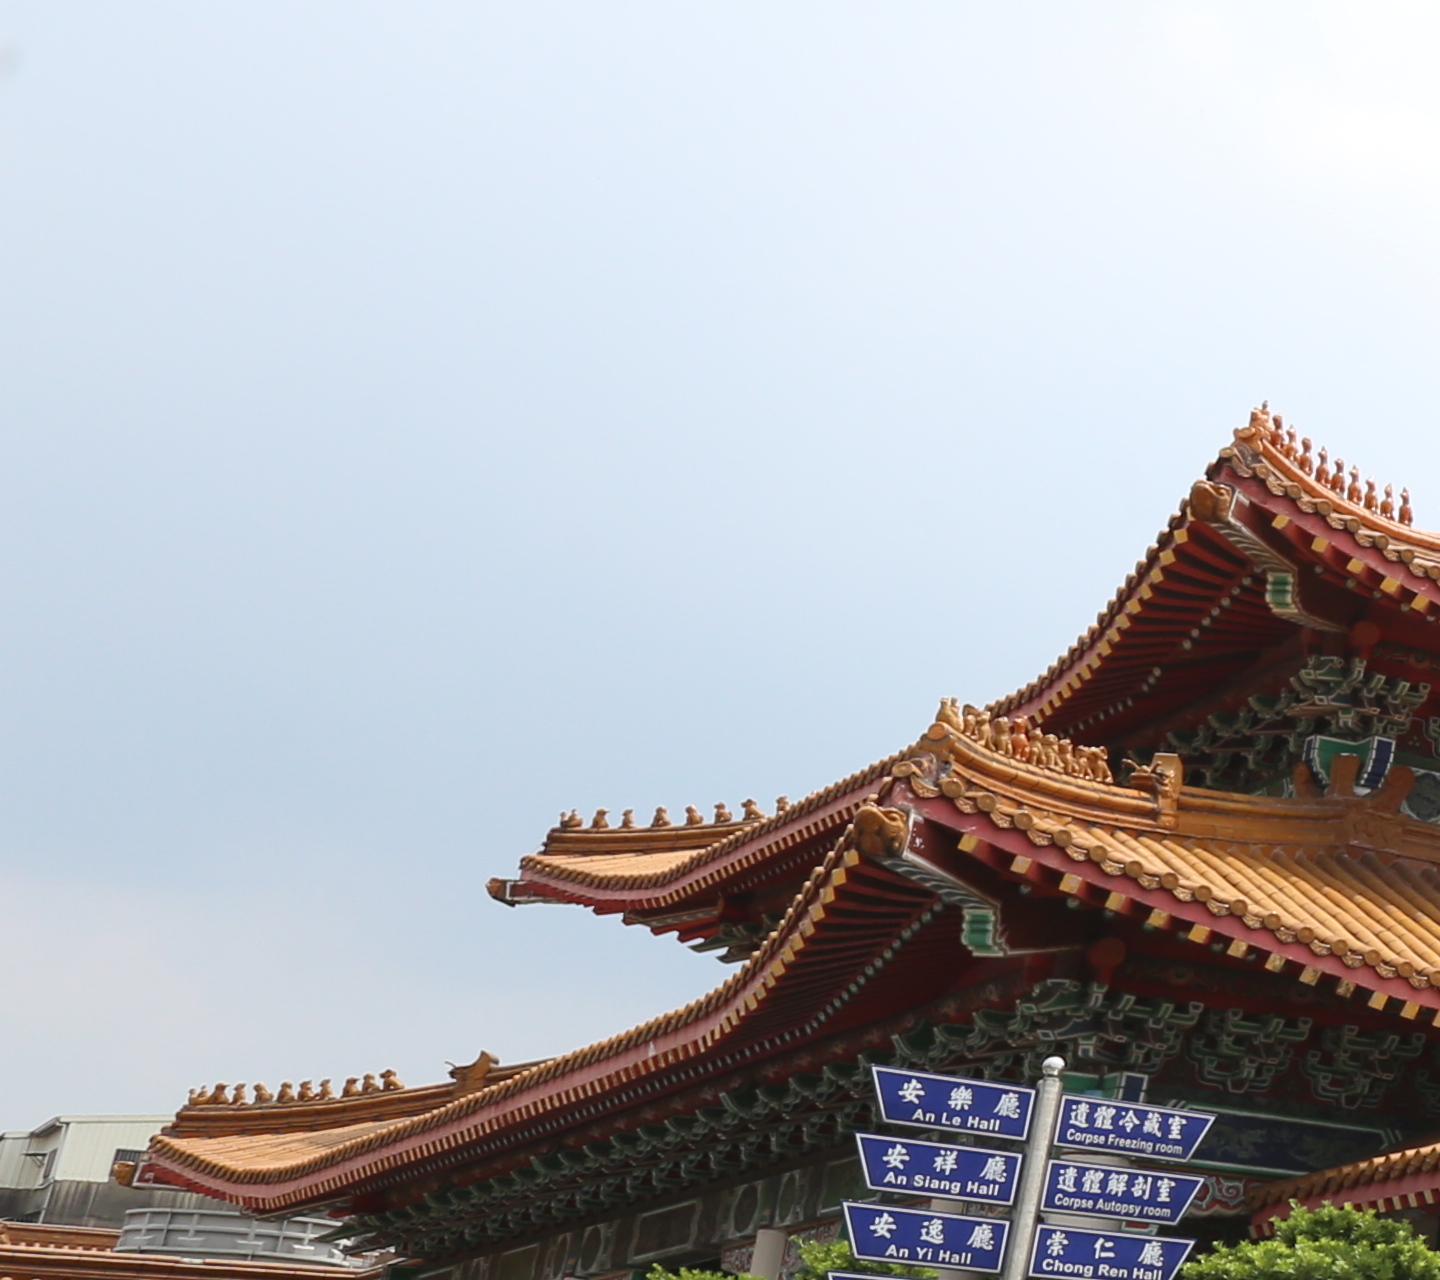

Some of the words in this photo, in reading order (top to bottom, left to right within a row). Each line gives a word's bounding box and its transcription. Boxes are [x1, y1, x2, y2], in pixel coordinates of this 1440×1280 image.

[898, 1079, 1021, 1118] 安樂廳
[912, 1109, 935, 1122] An
[942, 1113, 961, 1125] Le
[968, 1116, 999, 1131] Hall
[1069, 1102, 1187, 1139] 遺體冷藏室
[1067, 1129, 1105, 1144] Corpse
[1108, 1135, 1153, 1152] Freezing
[1155, 1143, 1182, 1154] room
[882, 1144, 1007, 1182] 安祥廳
[883, 1172, 907, 1185] An
[913, 1175, 961, 1194] Siang
[967, 1181, 999, 1196] Hall
[1057, 1167, 1176, 1202] 遺體解剖室
[1055, 1194, 1093, 1209] Corpse
[1096, 1199, 1141, 1216] Autopsy
[1143, 1206, 1170, 1217] room
[869, 1213, 995, 1250] 安逸廳
[885, 1245, 908, 1257] An
[917, 1247, 932, 1260] Yi
[939, 1250, 971, 1264] Hall
[1046, 1231, 1164, 1267] 崇仁廳
[1042, 1259, 1094, 1277] Chong
[1098, 1264, 1127, 1278] Ren
[1133, 1268, 1162, 1280] Hall
